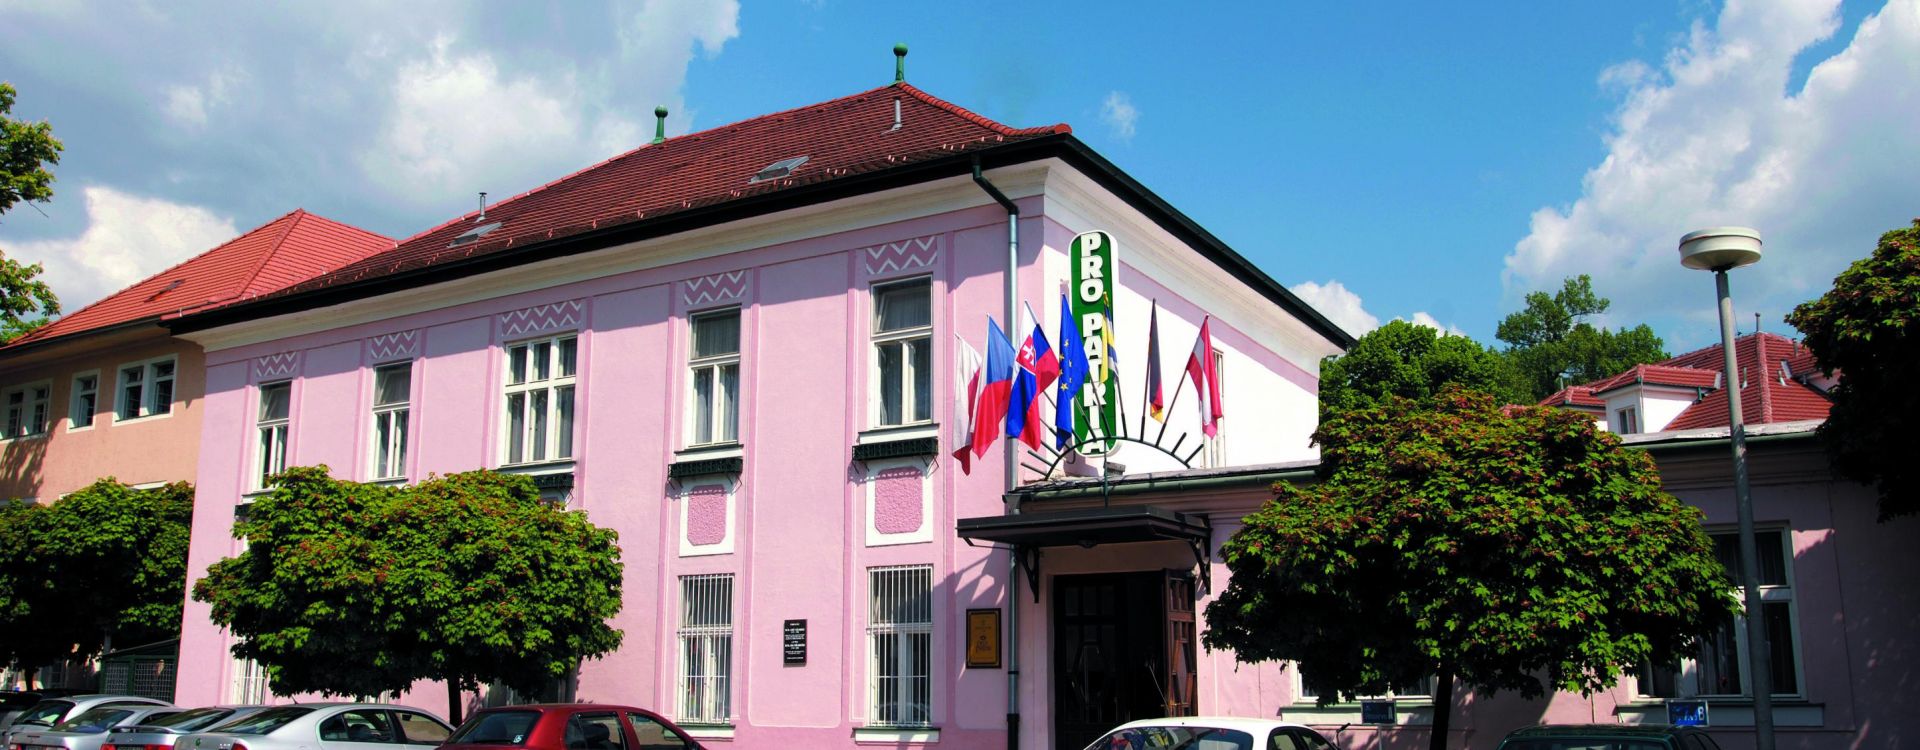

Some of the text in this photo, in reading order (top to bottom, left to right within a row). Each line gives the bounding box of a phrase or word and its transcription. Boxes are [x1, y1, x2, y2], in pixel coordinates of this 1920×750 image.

[1080, 232, 1109, 454] PRO PATRIA
[1697, 706, 1705, 721] B
